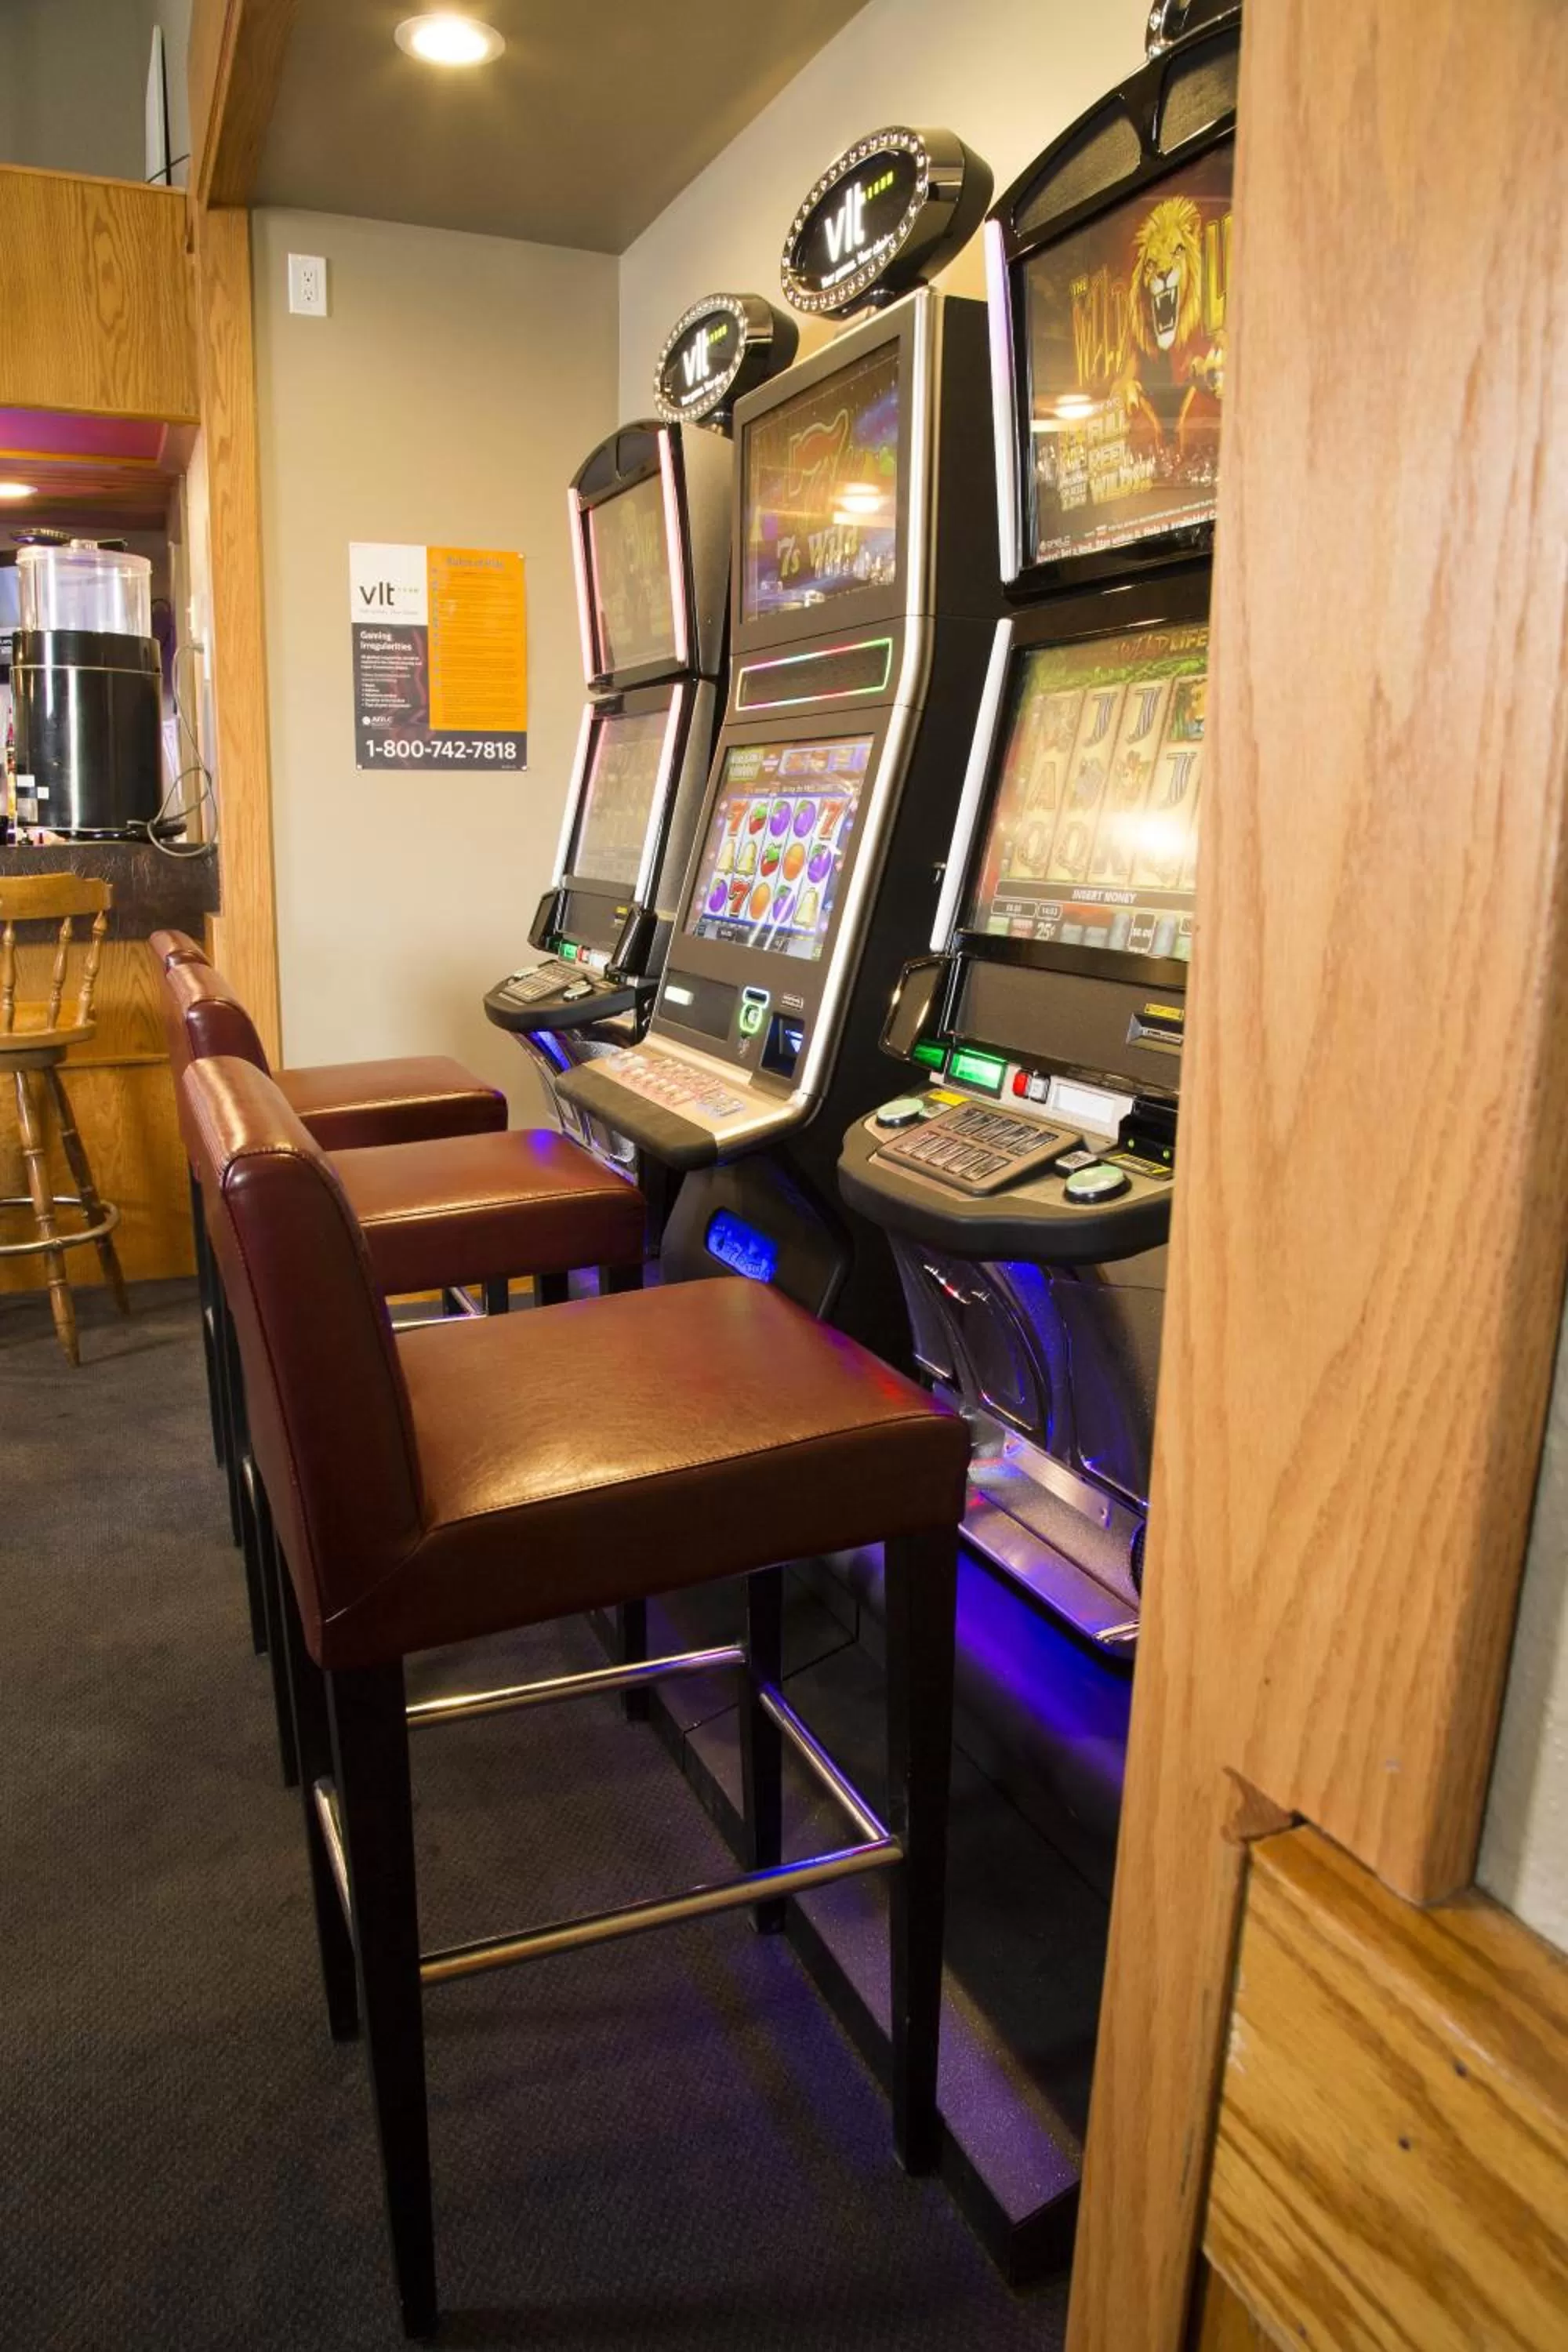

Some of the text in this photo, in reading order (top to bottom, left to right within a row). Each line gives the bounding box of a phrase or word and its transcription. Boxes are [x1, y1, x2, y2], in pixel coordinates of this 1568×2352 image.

[824, 180, 866, 263] vlt
[683, 327, 710, 387] vlt
[359, 581, 395, 606] vlt
[360, 630, 392, 642] Gaming
[360, 641, 413, 652] Irregularities
[365, 739, 517, 760] 1-800-742-7818
[1072, 889, 1138, 905] INSERT MONEY
